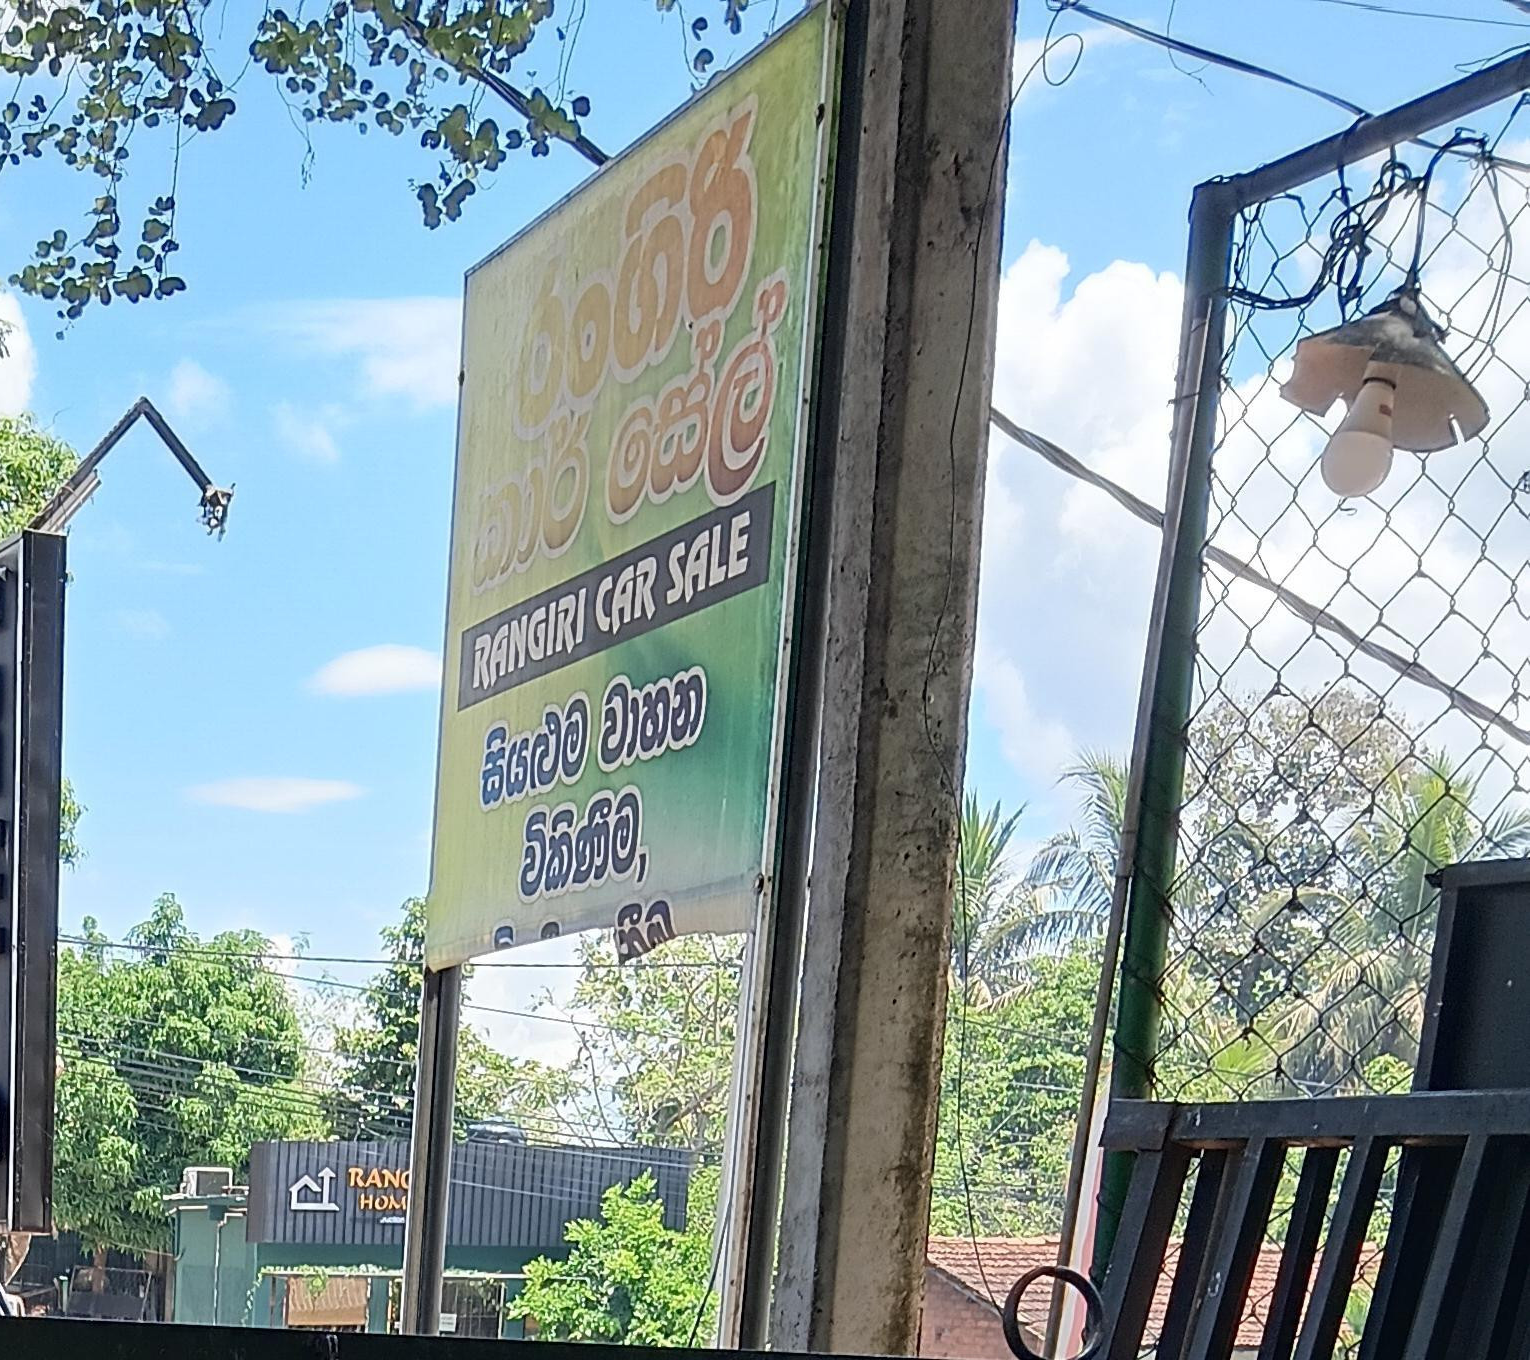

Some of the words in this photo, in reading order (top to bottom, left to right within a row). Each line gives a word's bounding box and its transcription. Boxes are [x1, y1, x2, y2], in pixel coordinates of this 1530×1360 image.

[517, 98, 755, 432] රංගිරි
[608, 272, 786, 521] සේල්
[472, 587, 587, 691] RANGIRI
[595, 555, 657, 635] CAR
[666, 510, 751, 603] SALE
[600, 670, 705, 769] වාහන
